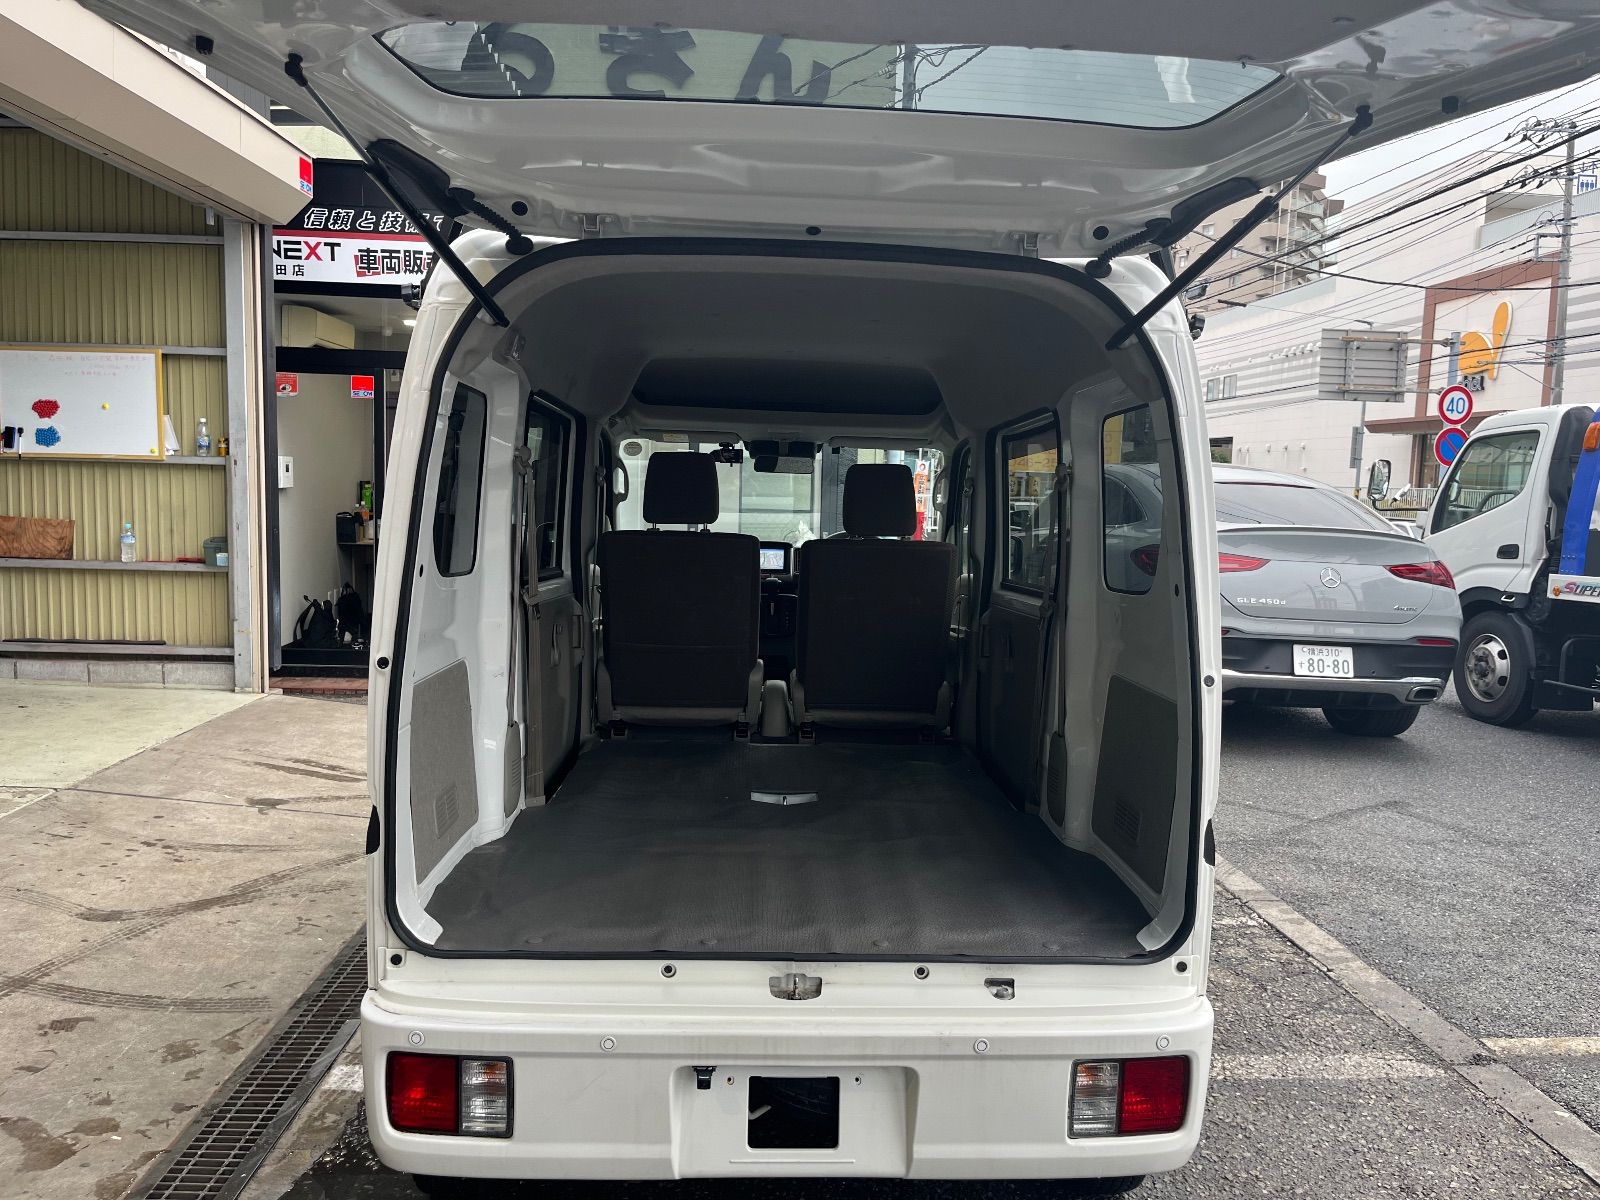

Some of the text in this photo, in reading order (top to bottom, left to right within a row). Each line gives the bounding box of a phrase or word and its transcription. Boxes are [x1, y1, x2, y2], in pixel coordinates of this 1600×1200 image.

[303, 208, 445, 233] 信頼と技
[1445, 397, 1466, 415] 40
[1307, 657, 1350, 675] 80-80
